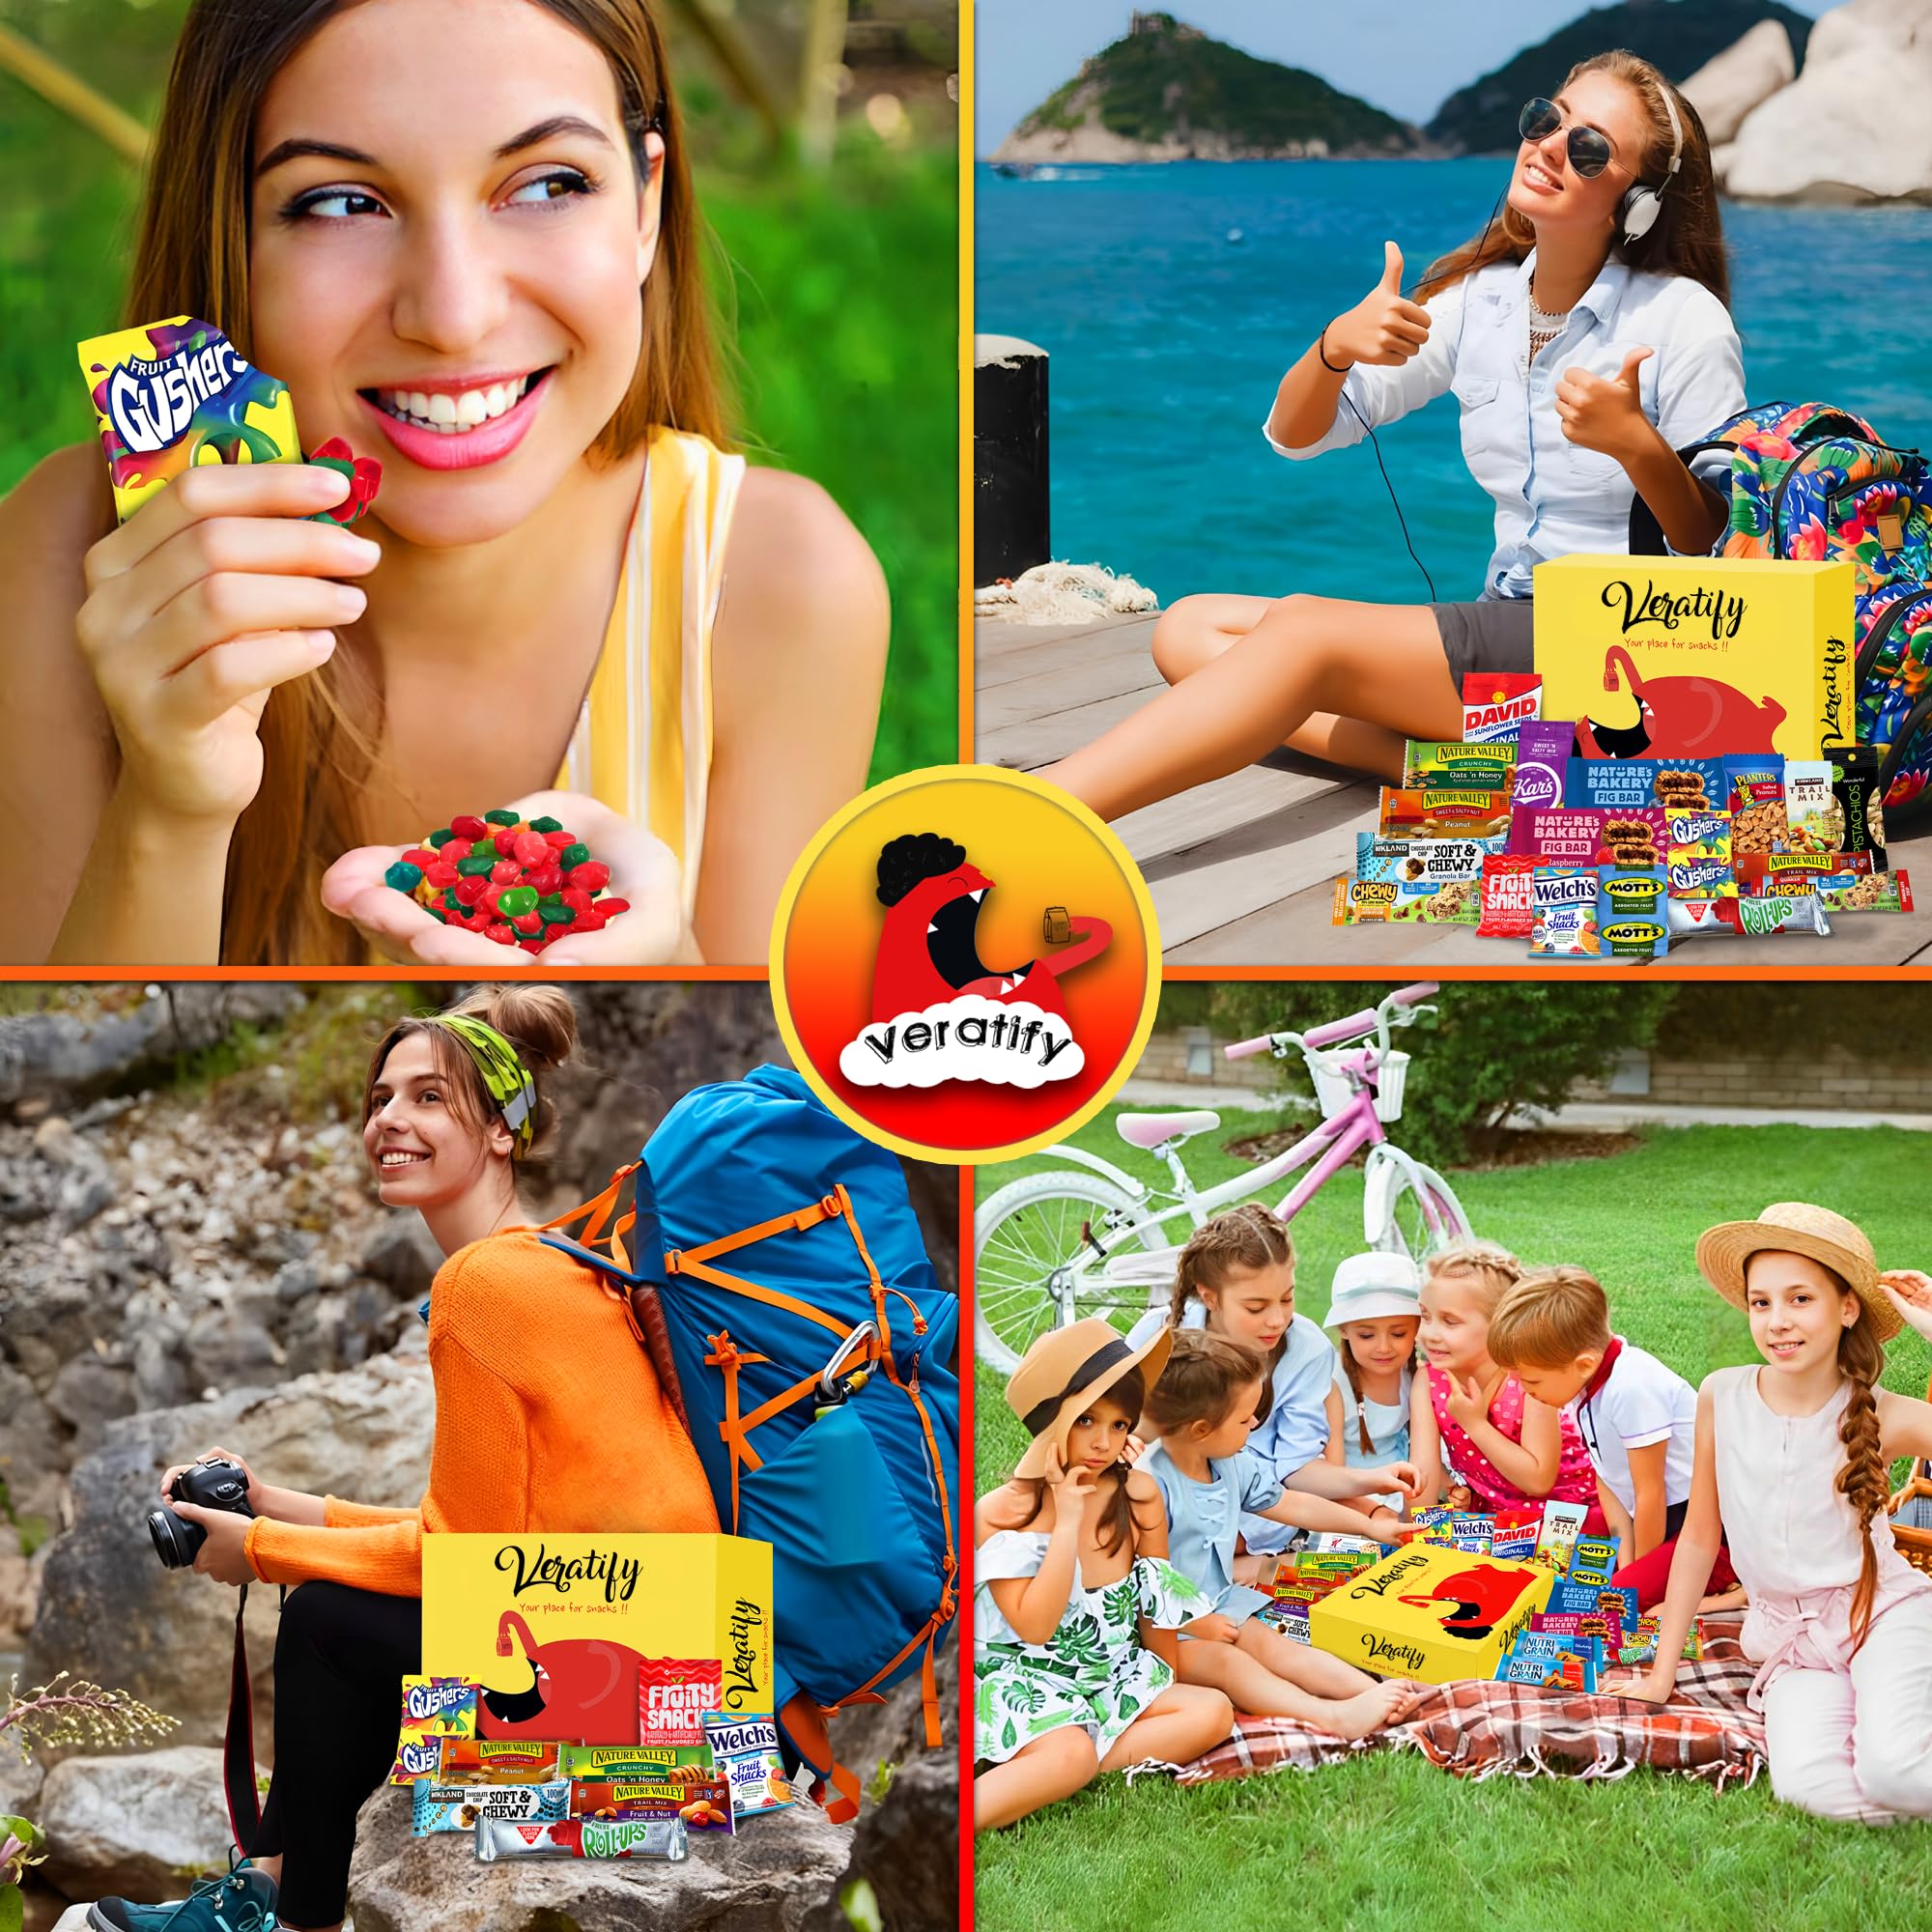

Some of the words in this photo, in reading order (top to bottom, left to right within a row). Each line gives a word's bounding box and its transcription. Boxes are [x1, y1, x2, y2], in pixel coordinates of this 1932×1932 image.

[129, 357, 172, 377] FRUIT
[1601, 580, 1748, 639] Veratify
[1624, 638, 1644, 648] Your
[1647, 639, 1668, 650] place
[1672, 639, 1685, 649] for
[1689, 640, 1718, 651] snacks
[1820, 635, 1846, 760] Veratify
[1465, 698, 1537, 730] DAVID
[1474, 722, 1514, 736] SUNFLOWER
[1514, 715, 1532, 725] SEEDS
[1440, 747, 1476, 759] NATURE
[1477, 747, 1511, 760] VALLEY
[1587, 778, 1653, 789] BAKERY
[1735, 773, 1776, 786] PLANTERS
[1514, 777, 1553, 798] Kar's
[1425, 793, 1457, 807] NATURE
[1457, 792, 1488, 808] VALLEY
[1598, 793, 1615, 803] FIG
[1619, 793, 1640, 803] BAR
[1848, 784, 1864, 853] PISTACHIOS
[1533, 827, 1600, 838] BAKERY
[1672, 817, 1723, 843] Gushers
[1434, 844, 1462, 859] SOFT
[1463, 844, 1477, 857] &
[1544, 842, 1562, 852] FIG
[1566, 843, 1588, 853] BAR
[1428, 859, 1475, 872] CHEWY
[1771, 856, 1802, 868] NATURE
[1802, 856, 1832, 869] VALLEY
[1672, 866, 1727, 889] Gushers
[1535, 879, 1596, 901] Welch's
[1608, 883, 1660, 893] MOTT'S
[1553, 911, 1576, 923] Fruit
[1547, 920, 1580, 931] Snacks
[1607, 927, 1660, 938] MOTT'S
[1453, 1521, 1493, 1535] Welch's
[1549, 1520, 1579, 1531] TRAIL
[1552, 1527, 1573, 1536] MIX
[1492, 1526, 1536, 1544] DAVID
[1492, 1547, 1524, 1557] ORIGINAL
[1579, 1546, 1611, 1555] MOTT'S
[494, 1543, 644, 1603] Veratify
[1299, 1569, 1317, 1577] NATURE
[1318, 1570, 1335, 1580] VALLEY
[1350, 1554, 1430, 1600] Veratify
[1574, 1573, 1605, 1583] MOTT'S
[1295, 1589, 1313, 1600] VALLEY
[1561, 1592, 1597, 1601] BAKERY
[519, 1603, 540, 1613] Your
[543, 1604, 564, 1615] place
[568, 1603, 582, 1613] for
[587, 1604, 617, 1614] snacks
[1293, 1619, 1309, 1630] SOFT
[1288, 1626, 1311, 1638] CHEWY
[1525, 1637, 1555, 1648] NUTRI
[724, 1597, 762, 1709] Veratify
[1361, 1634, 1426, 1670] Veratify
[1523, 1646, 1555, 1657] GRAIN
[1511, 1662, 1543, 1671] NUTRI
[1509, 1670, 1543, 1680] GRAIN
[419, 1685, 438, 1693] FRUIT
[409, 1687, 470, 1719] Gushers
[706, 1725, 777, 1752] Welch's
[482, 1744, 512, 1755] NATURE
[512, 1744, 541, 1756] VALLEY
[595, 1750, 635, 1764] NATURE
[635, 1750, 673, 1764] VALLEY
[737, 1759, 761, 1775] Fruit
[730, 1769, 767, 1786] Snacks
[489, 1791, 517, 1804] SOFT
[519, 1790, 531, 1803] &
[615, 1786, 648, 1800] NATURE
[649, 1785, 683, 1800] VALLEY
[483, 1805, 530, 1818] CHEWY
[583, 1823, 646, 1859] ROLL-UPS
